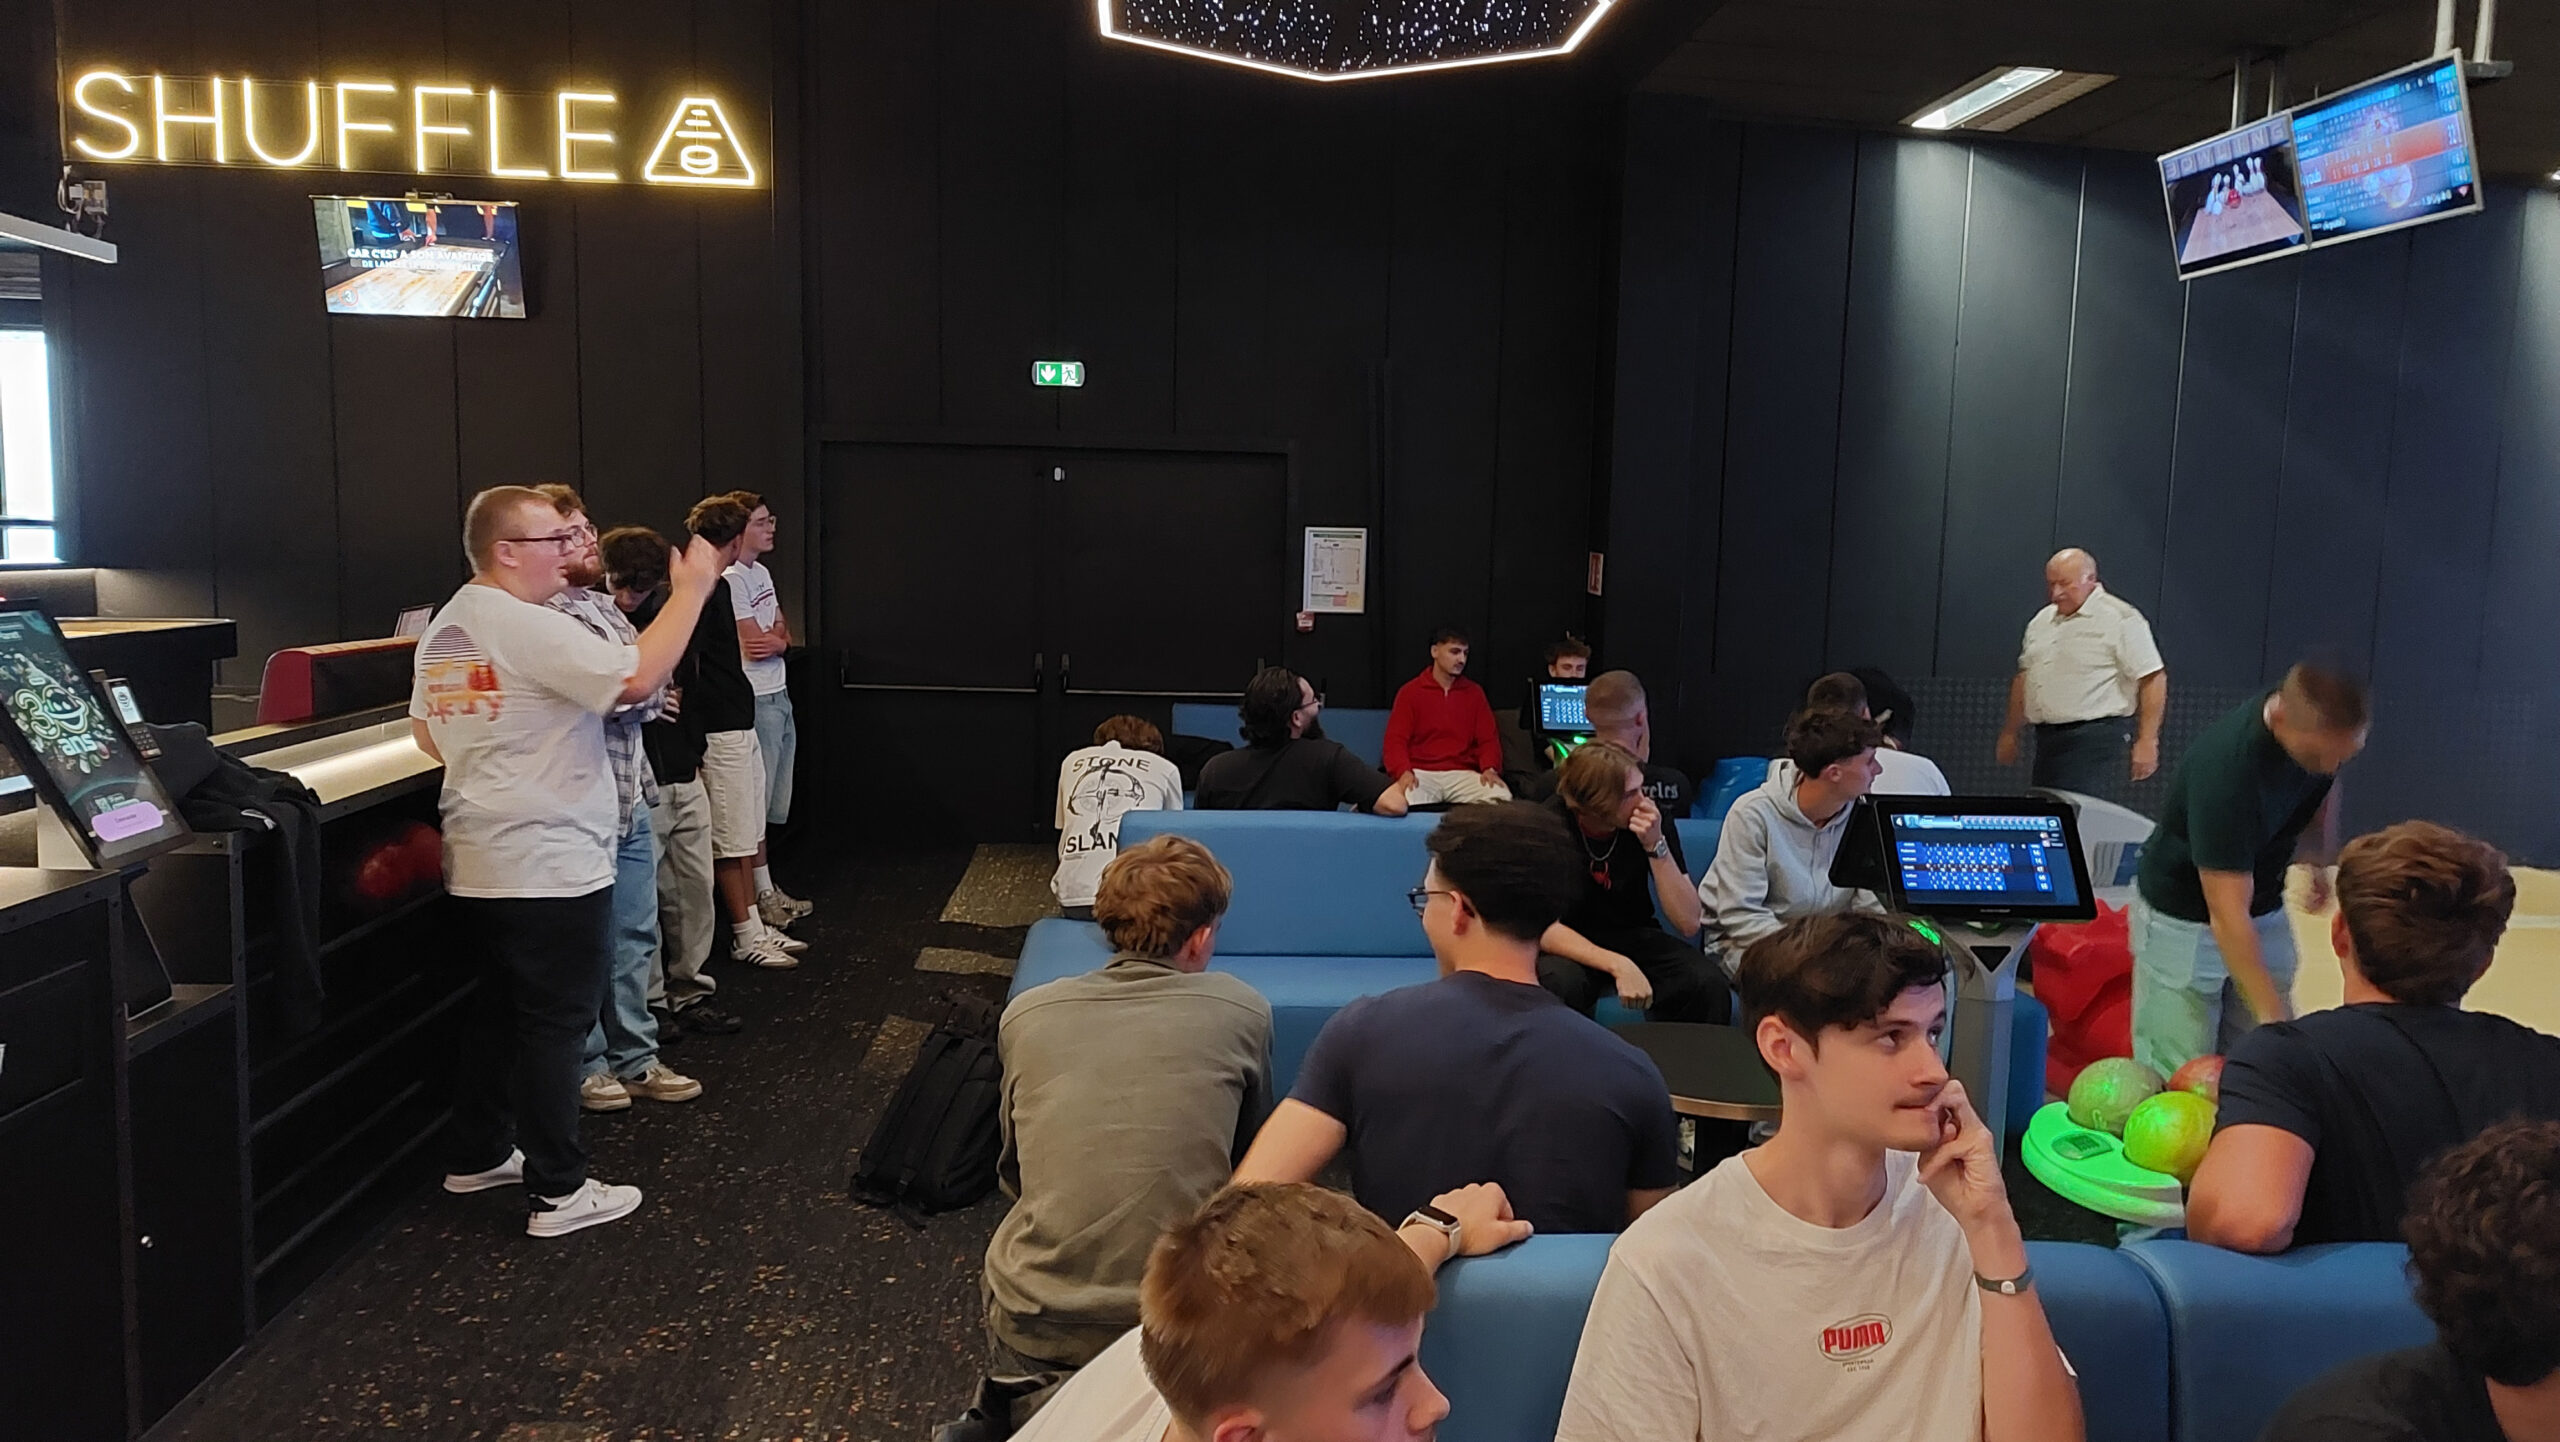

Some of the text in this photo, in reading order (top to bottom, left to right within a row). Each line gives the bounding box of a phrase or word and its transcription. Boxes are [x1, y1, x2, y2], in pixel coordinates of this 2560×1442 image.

[73, 70, 618, 181] SHUFFLE
[2165, 123, 2284, 179] BOWLING
[347, 248, 370, 259] CAR
[362, 260, 374, 268] DE
[58, 733, 98, 756] ans
[1072, 756, 1150, 773] STONE
[1642, 781, 1679, 799] eles
[1062, 831, 1118, 856] SLAN
[1823, 1321, 1885, 1354] PUMA
